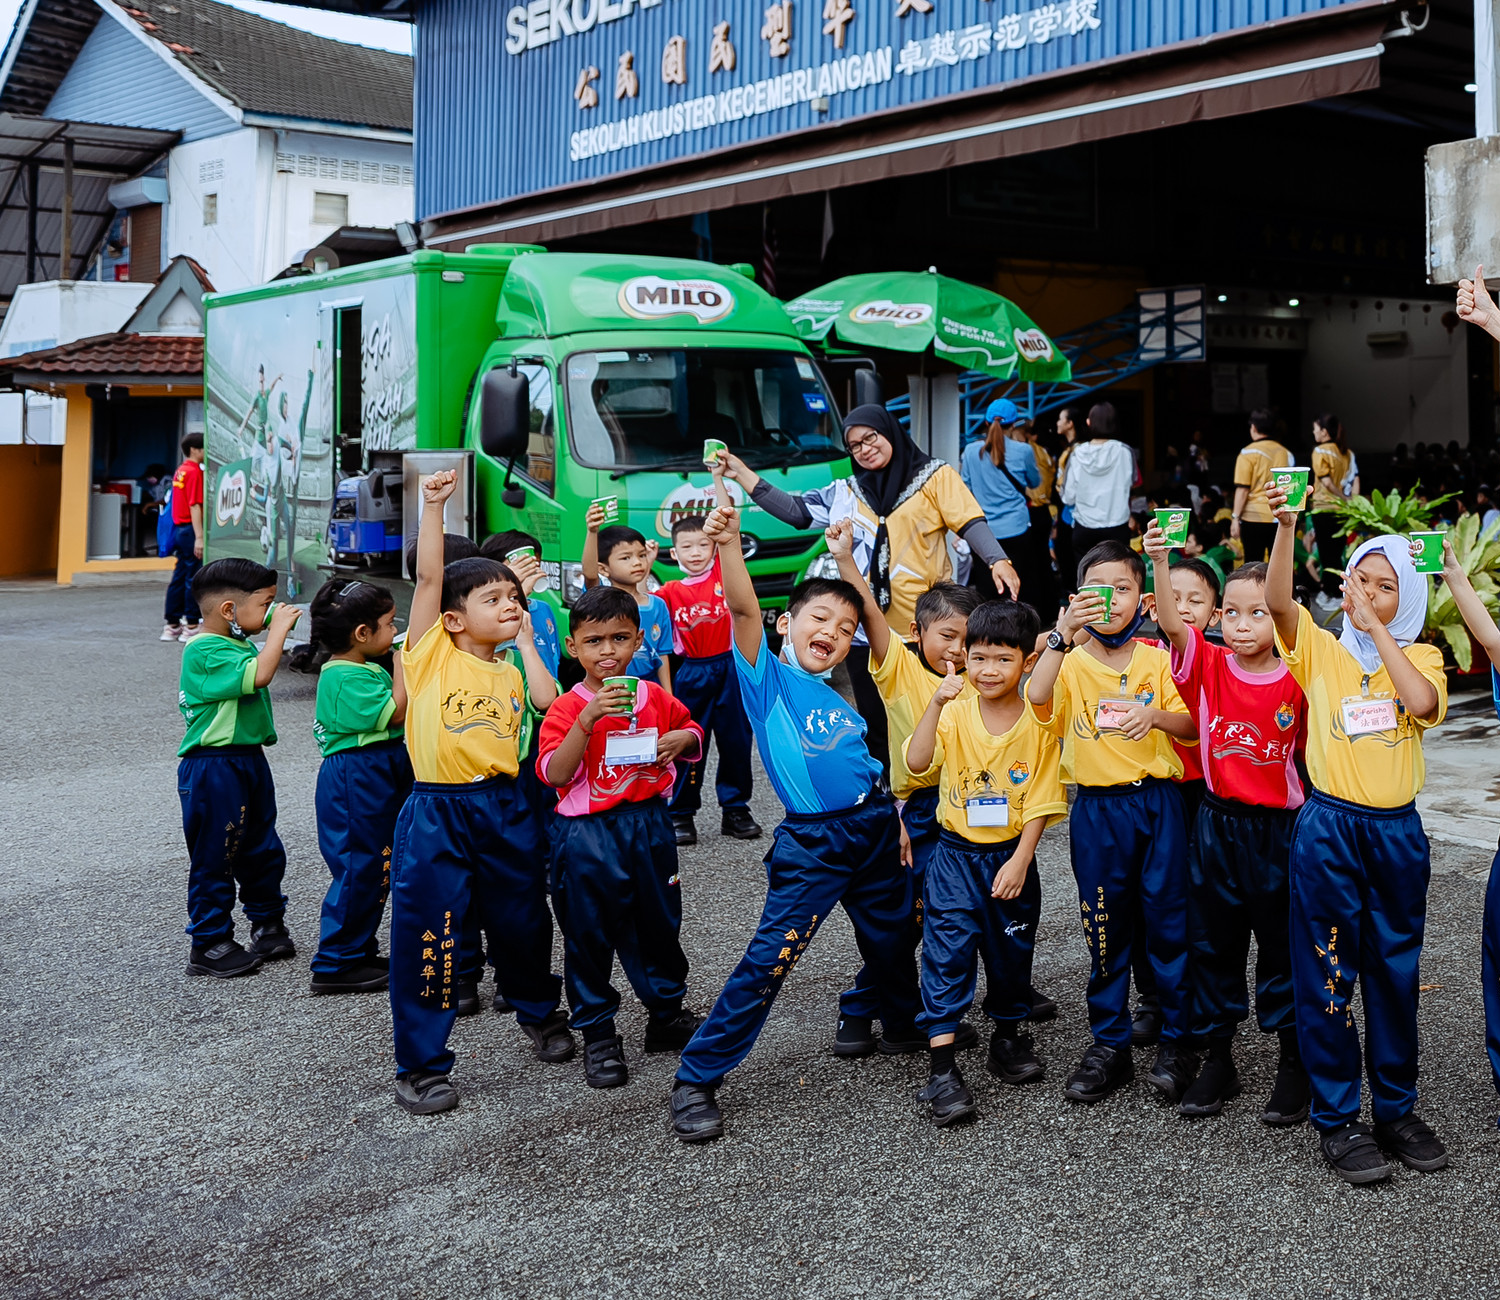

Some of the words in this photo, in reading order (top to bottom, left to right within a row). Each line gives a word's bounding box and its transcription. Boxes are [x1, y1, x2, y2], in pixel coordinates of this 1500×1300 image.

[569, 115, 641, 163] SEKOLAH
[642, 88, 717, 143] KLUSTER
[718, 46, 893, 124] KECEMERLANGAN
[637, 286, 720, 308] MILO
[863, 305, 925, 321] MILO
[941, 316, 975, 335] ENERGY
[978, 326, 996, 338] TO
[943, 326, 957, 337] GO
[959, 329, 1007, 347] FURTHER
[1018, 333, 1048, 354] MILO
[220, 486, 243, 514] MILO
[1360, 715, 1390, 727] 法丽莎
[1361, 706, 1387, 717] Farisha
[1094, 913, 1109, 923] (C)
[440, 939, 455, 951] (C)
[1097, 926, 1107, 957] KONG
[1328, 926, 1337, 951] SJK
[420, 929, 438, 998] 公民华小
[443, 953, 452, 984] KONG
[442, 987, 450, 1011] MIN
